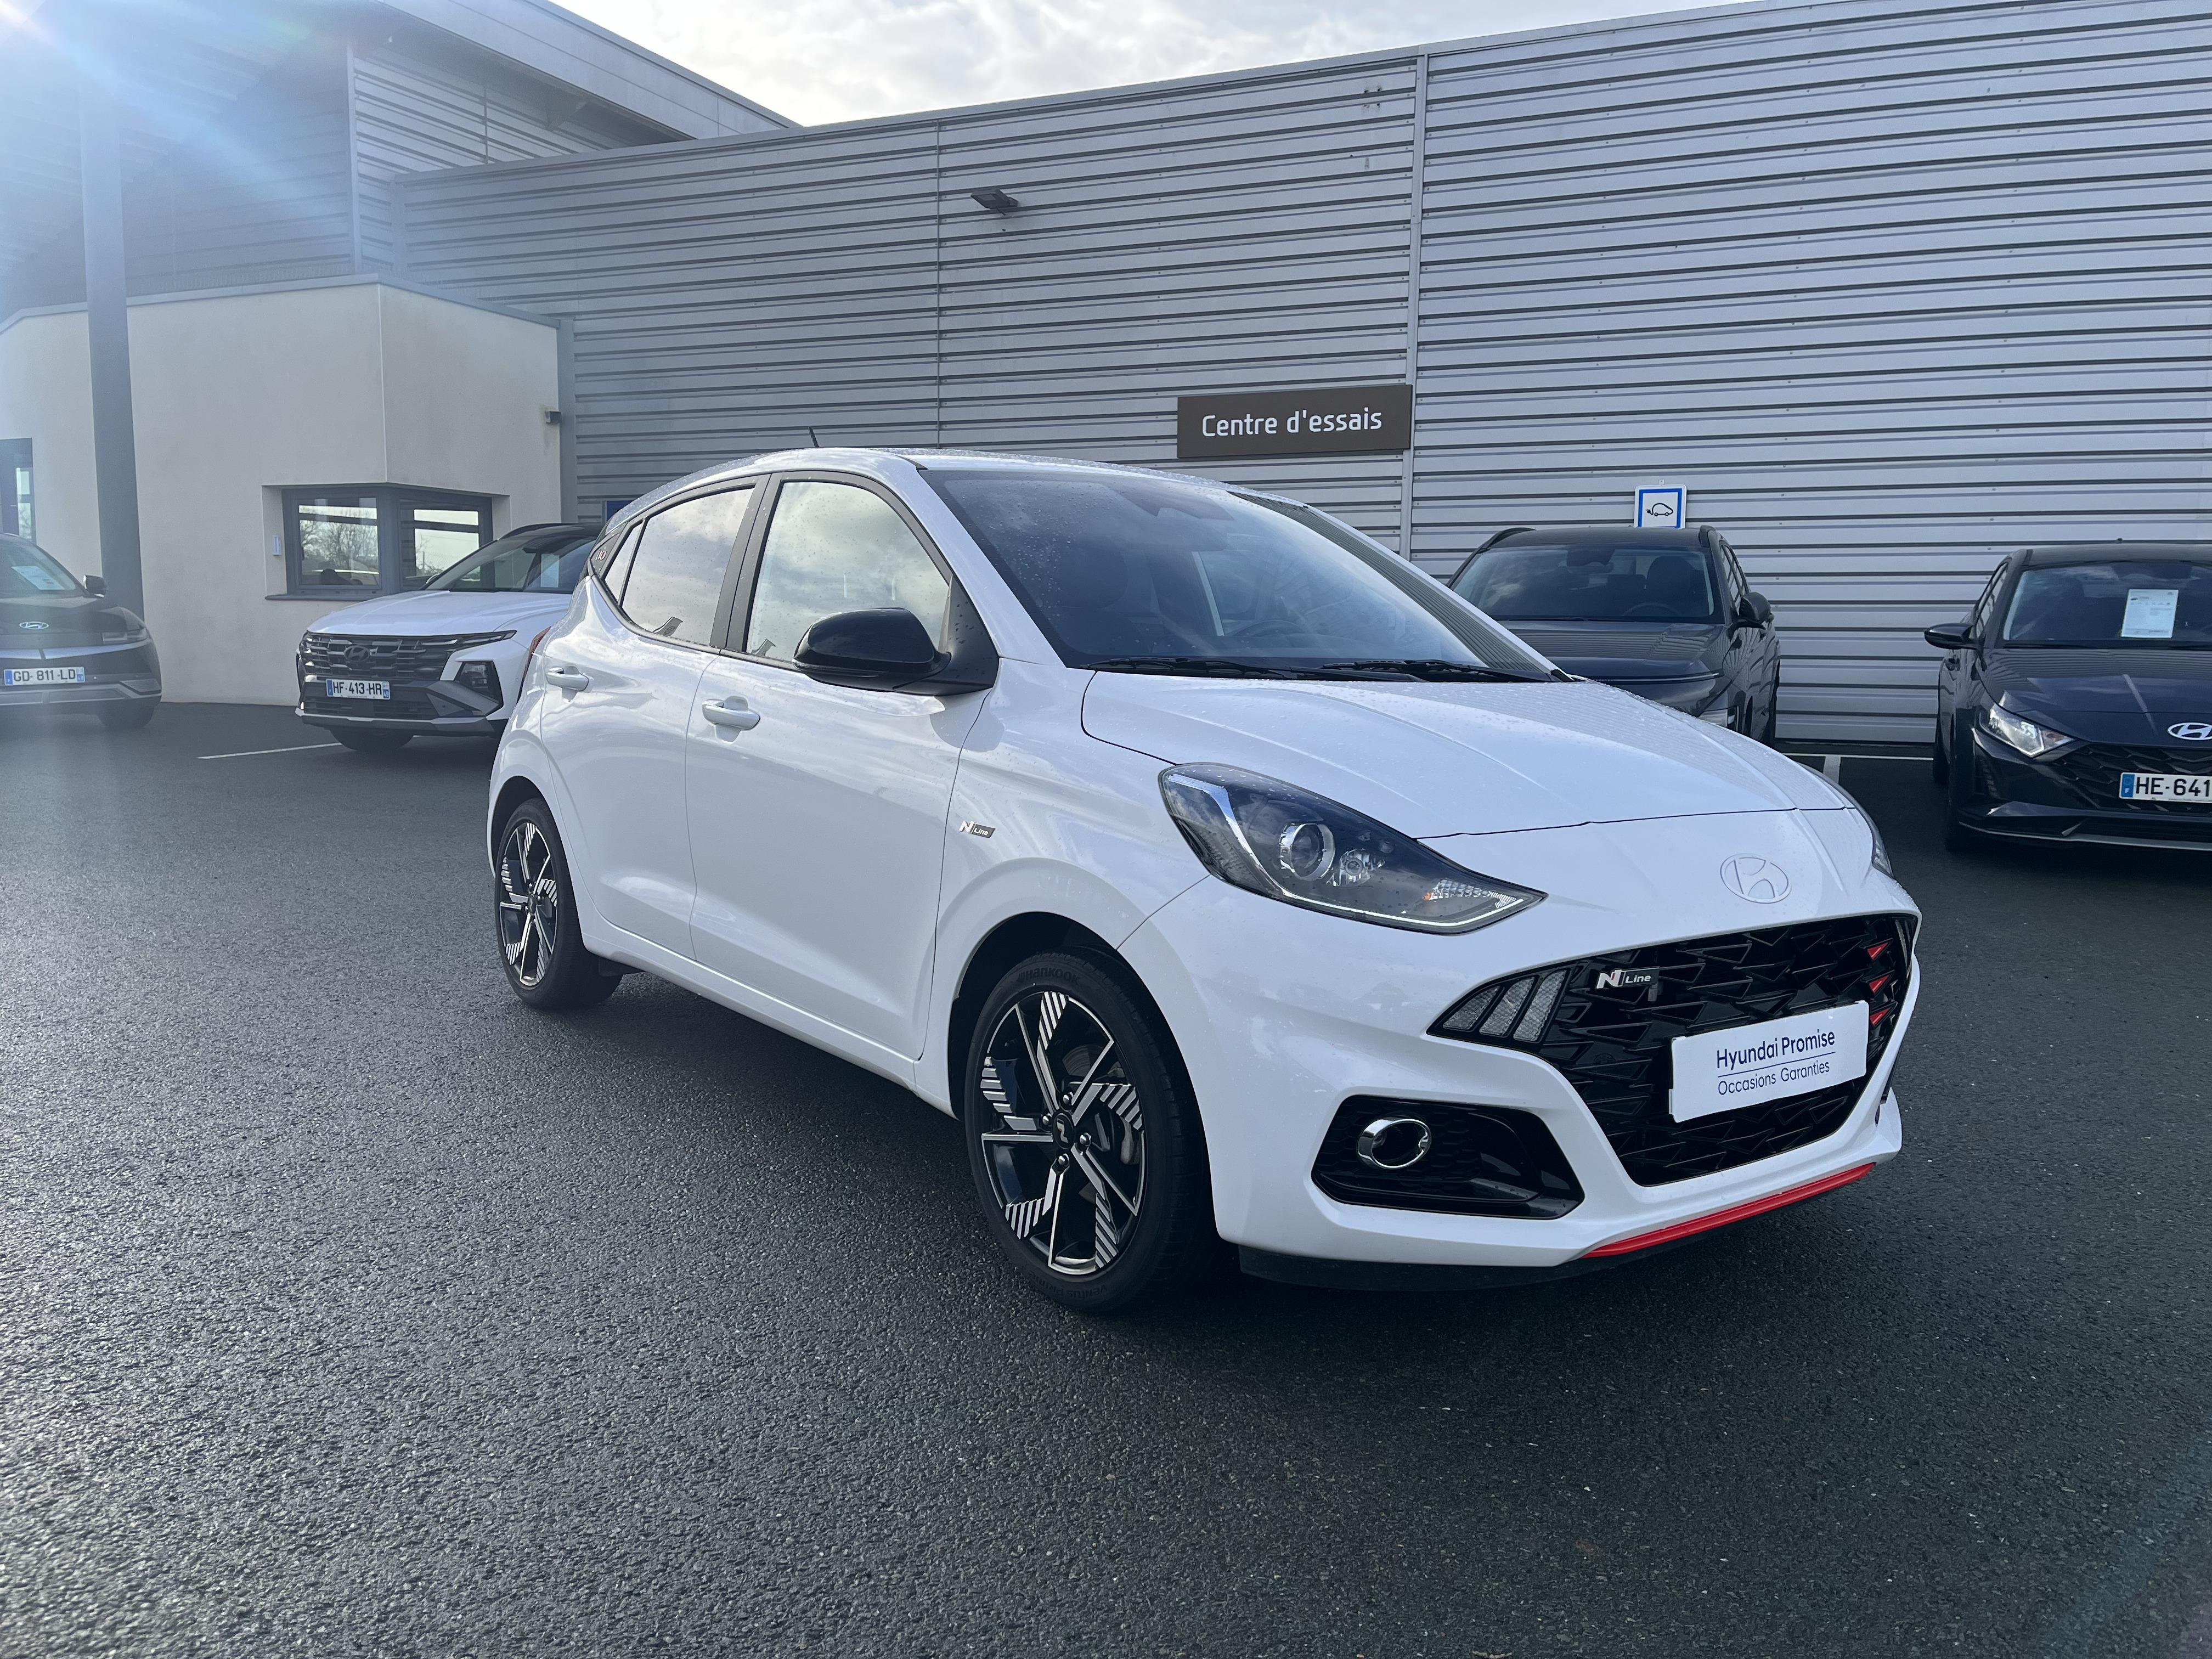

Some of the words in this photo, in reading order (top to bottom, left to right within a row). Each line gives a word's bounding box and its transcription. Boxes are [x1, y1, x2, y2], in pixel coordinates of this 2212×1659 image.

[1202, 414, 1278, 437] Centre
[1286, 407, 1382, 433] d'essais
[959, 820, 974, 833] N
[1596, 969, 1622, 989] N
[1625, 975, 1651, 983] Line
[1717, 1037, 1778, 1070] Hyundai
[1781, 1029, 1835, 1056] Promise
[1718, 1073, 1776, 1095] Occasions
[1781, 1060, 1830, 1082] Garanties
